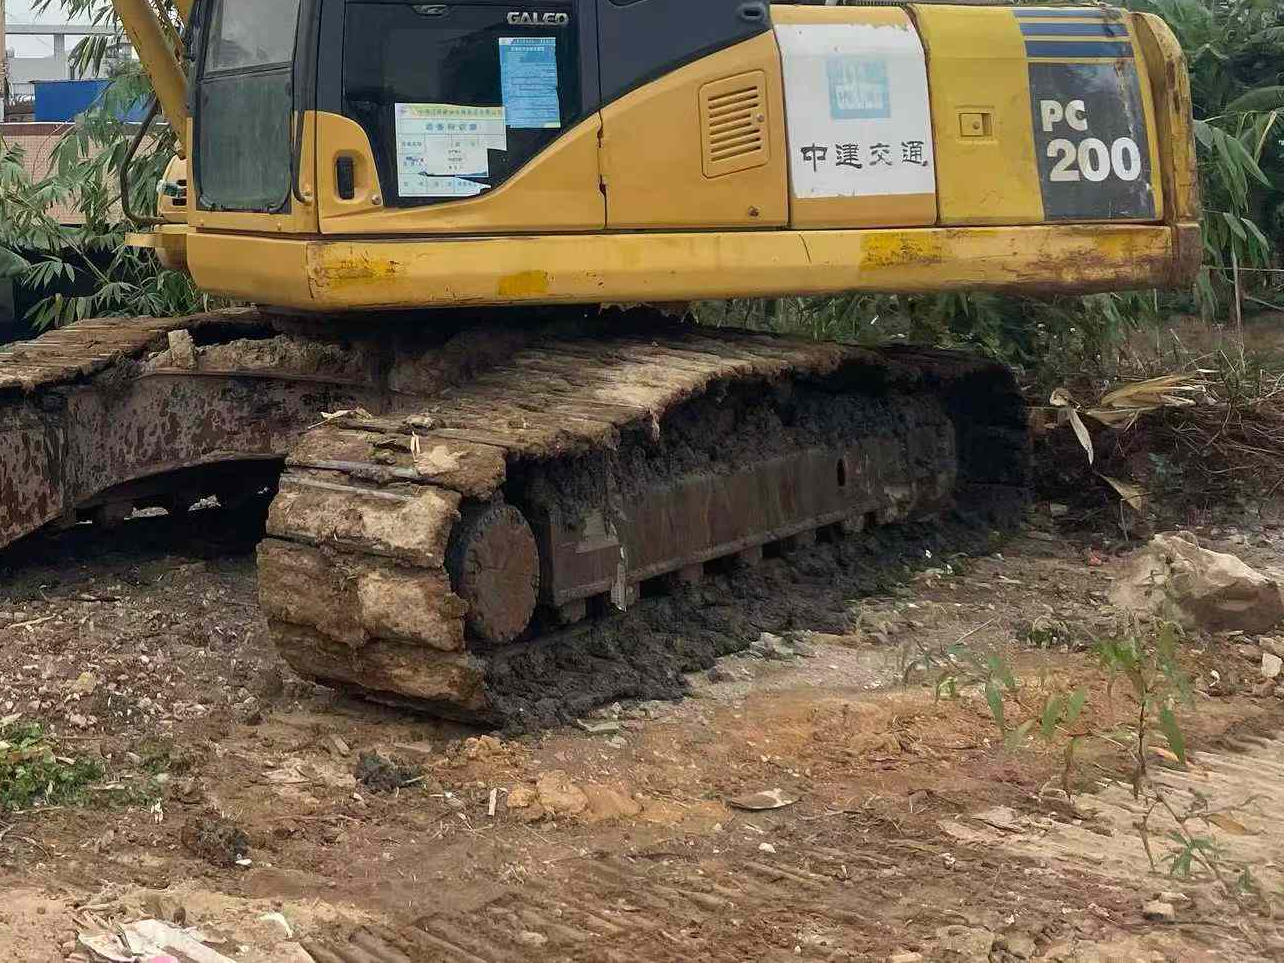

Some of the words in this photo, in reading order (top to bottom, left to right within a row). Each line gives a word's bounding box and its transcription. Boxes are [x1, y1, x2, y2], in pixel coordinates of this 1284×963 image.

[1040, 99, 1088, 132] PC
[800, 140, 929, 173] 中建交通
[1046, 137, 1141, 182] 200
